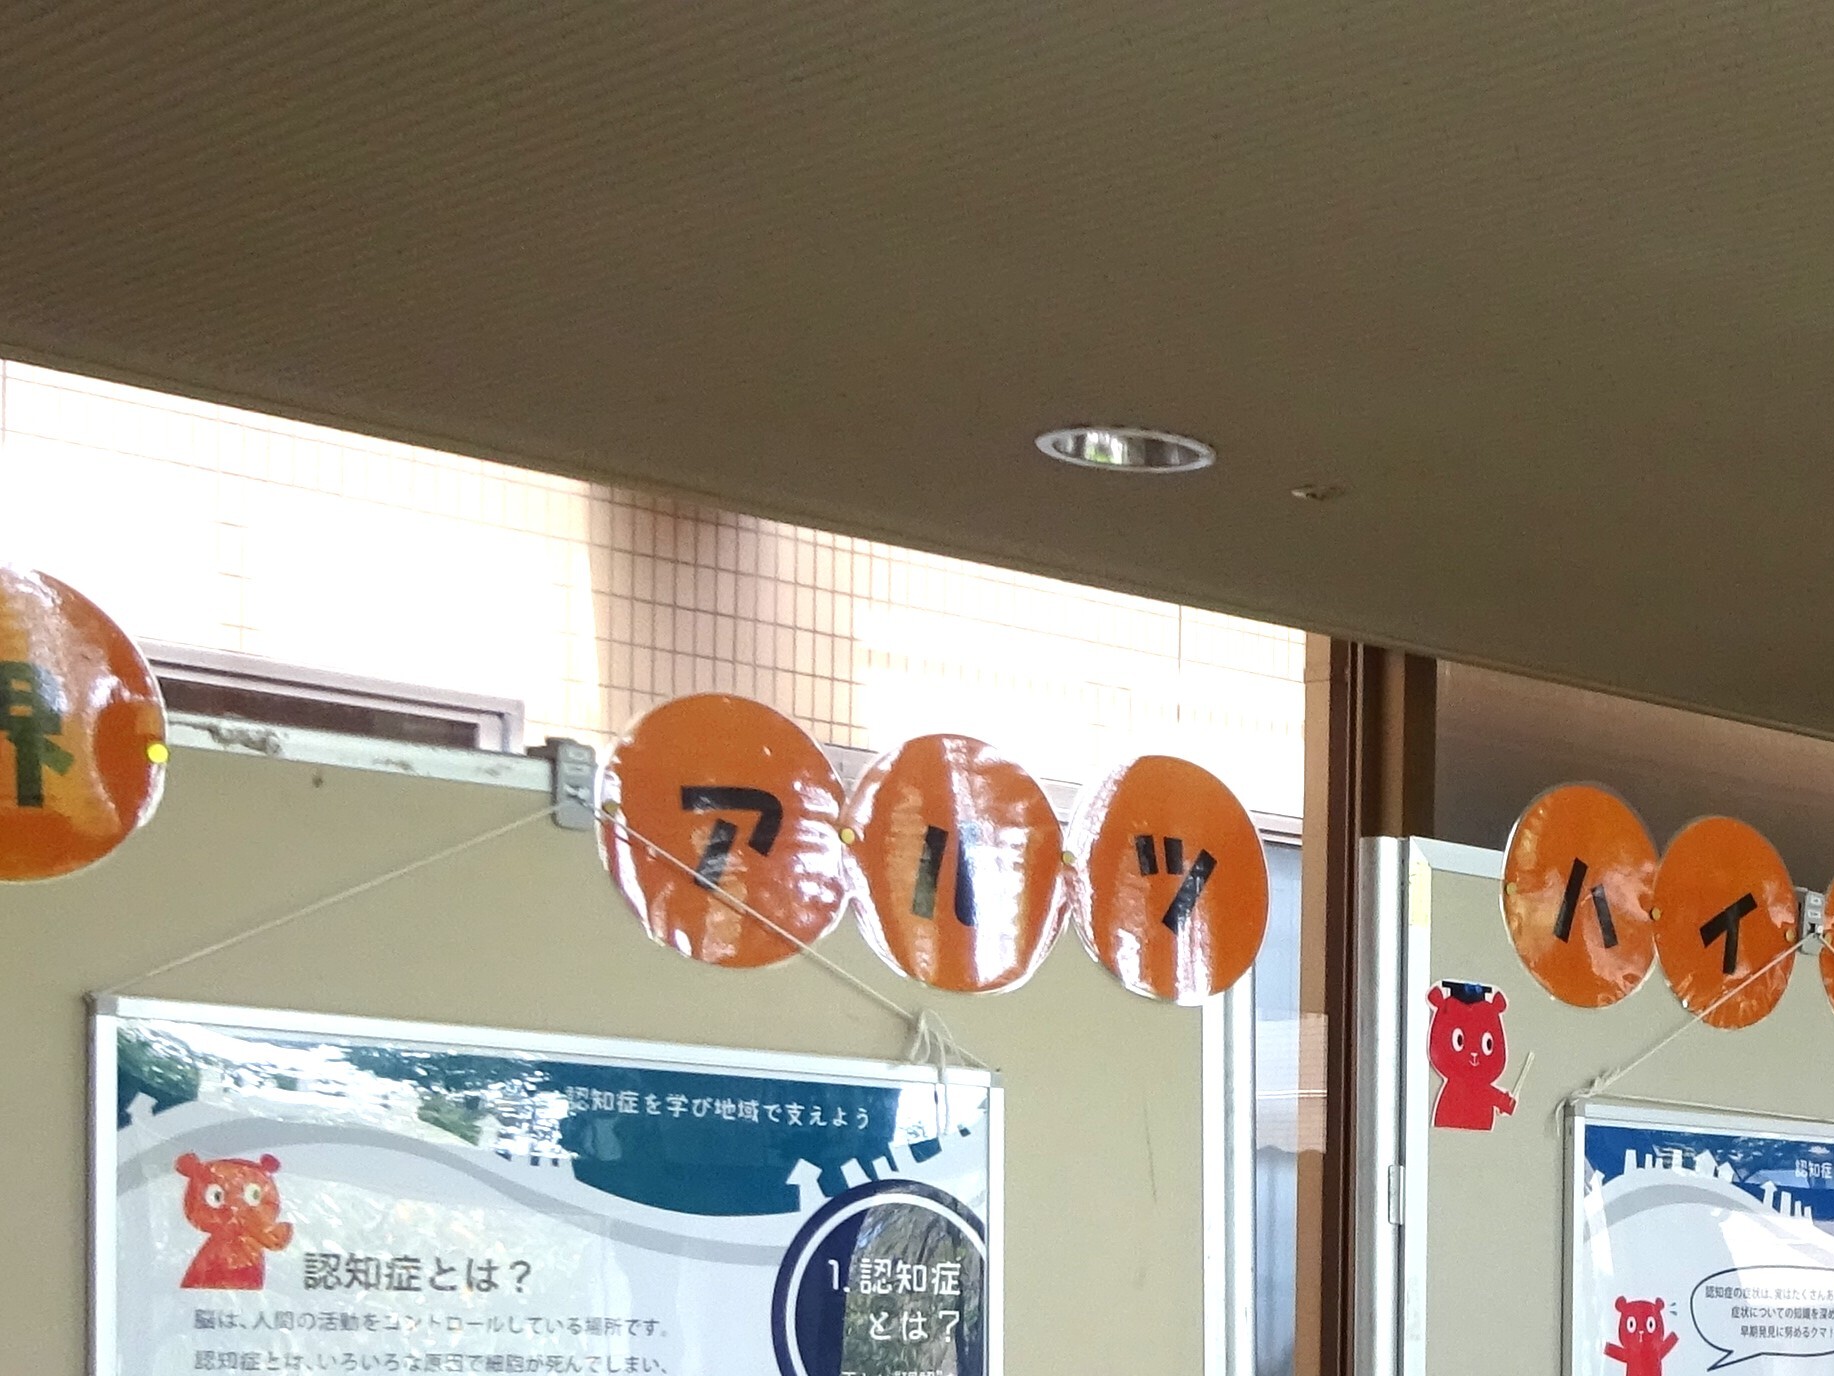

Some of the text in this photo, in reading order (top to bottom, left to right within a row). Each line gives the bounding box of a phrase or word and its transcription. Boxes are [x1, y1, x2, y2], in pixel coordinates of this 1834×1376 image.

[566, 1086, 871, 1130] 認知症を学び地域で支えよう
[304, 1253, 531, 1293] 認知症とは？
[193, 1309, 668, 1337] 脳は、人間の活動をコントロールしている場所です。
[869, 1311, 961, 1343] とは？
